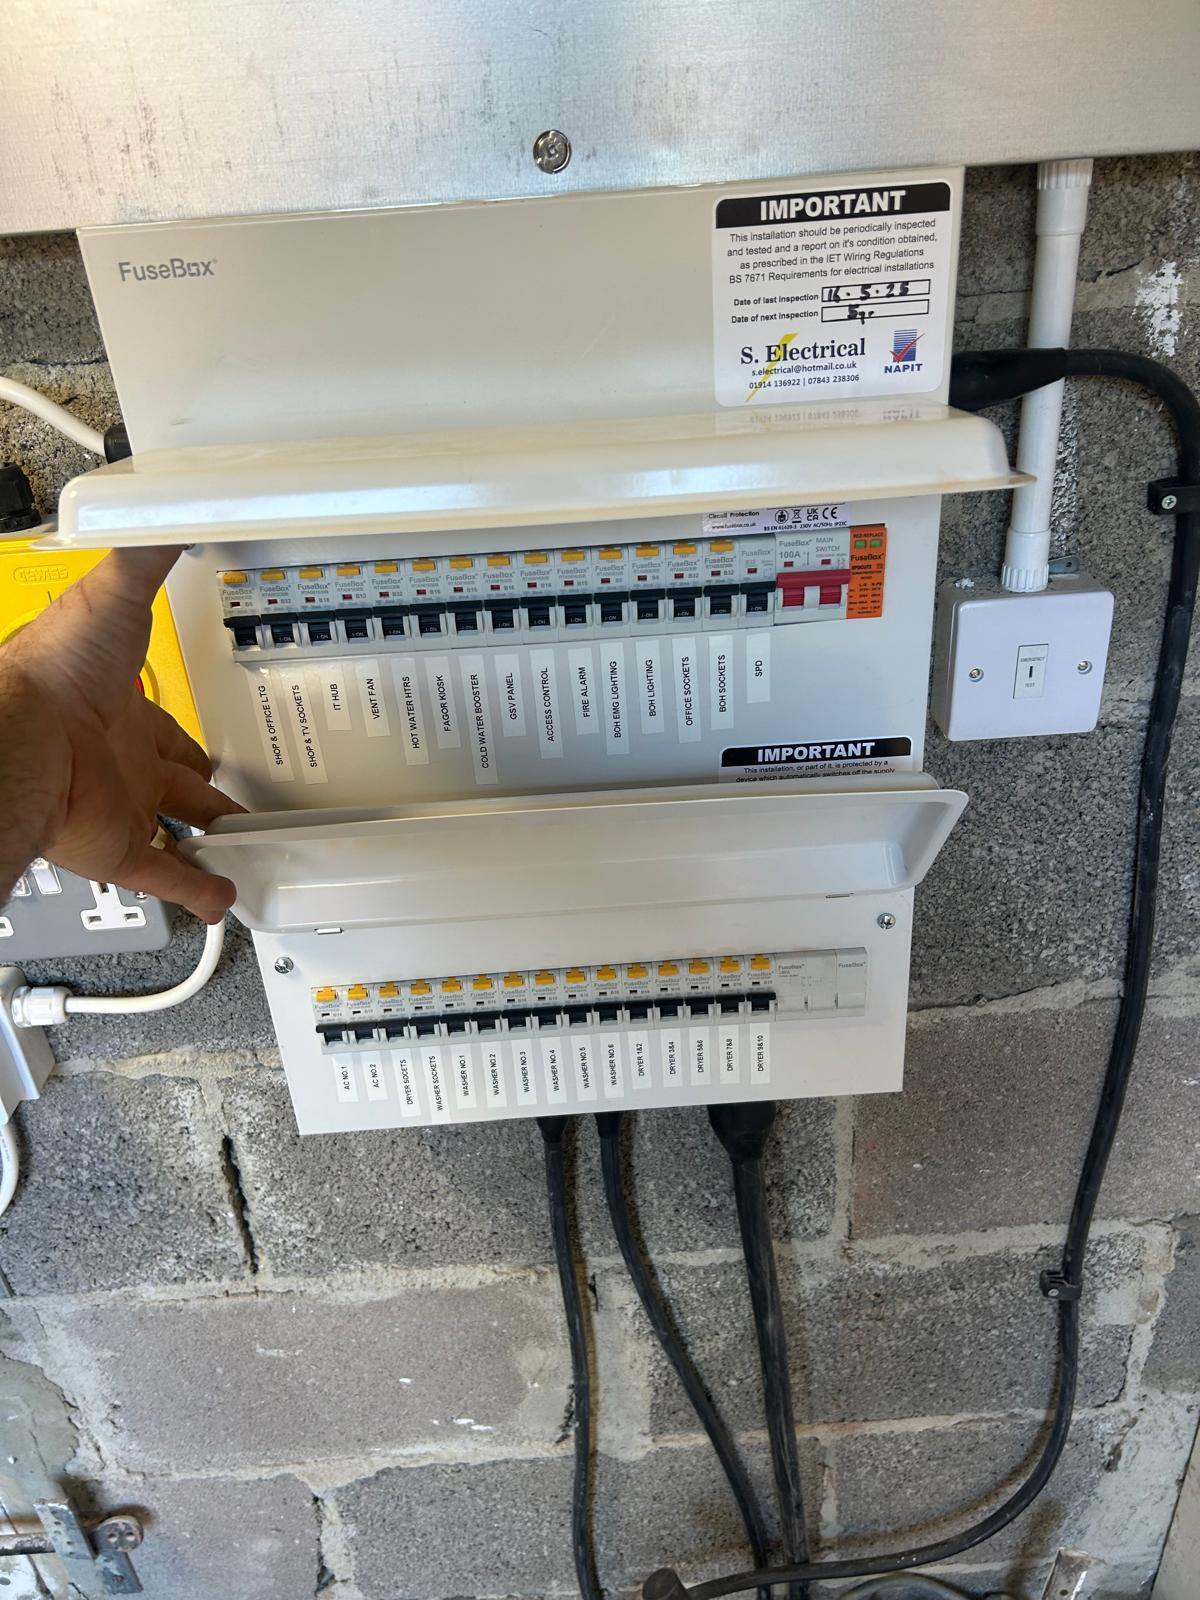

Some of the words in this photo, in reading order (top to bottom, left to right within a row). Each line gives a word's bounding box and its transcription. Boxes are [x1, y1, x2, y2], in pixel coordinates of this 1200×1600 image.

[761, 190, 906, 221] IMPORTANT
[730, 234, 747, 242] This
[751, 230, 796, 240] installation
[799, 227, 827, 237] should
[830, 226, 840, 234] be
[843, 222, 891, 235] periodically
[895, 218, 936, 230] inspected
[746, 246, 771, 255] tested
[775, 244, 790, 252] and
[802, 242, 826, 251] report
[843, 239, 854, 248] it's
[857, 236, 895, 247] condition
[753, 258, 797, 270] prescribed
[810, 255, 823, 264] the
[827, 254, 841, 262] IET
[844, 252, 870, 262] Wiring
[874, 249, 924, 260] Regulations
[730, 275, 742, 283] BS
[745, 273, 766, 282] 7671
[769, 269, 827, 281] Requirements
[830, 268, 841, 276] for
[844, 264, 881, 275] electrical
[885, 262, 934, 272] installations
[779, 293, 818, 303] inspection
[779, 311, 818, 320] inspection
[740, 347, 759, 365] S.
[766, 338, 866, 363] Electrical
[752, 361, 856, 376] s.electrical@hotmail.co.uk
[884, 363, 923, 374] NAPIT
[749, 381, 771, 389] 01914
[774, 379, 800, 388] 136922
[808, 376, 830, 385] 07843
[833, 374, 860, 383] 238306
[822, 507, 838, 519] CE
[14, 567, 68, 582] GEWISS
[366, 678, 376, 696] FAN
[505, 673, 516, 700] PANEL
[578, 666, 589, 696] ALARM
[610, 661, 619, 698] LIGHTING
[646, 659, 655, 697] LIGHTING
[682, 656, 691, 696] SOCKETS
[258, 685, 269, 702] LTG
[330, 683, 340, 701] HUB
[403, 676, 411, 699] HTRS
[436, 675, 447, 701] KIOSK
[470, 673, 482, 714] BOOSTER
[541, 668, 551, 707] CONTROL
[292, 684, 307, 724] SOCKETS
[369, 698, 379, 719] VENT
[508, 702, 517, 720] GSV
[582, 698, 590, 718] FIRE
[612, 700, 620, 720] EMG
[262, 703, 276, 734] OFFICE
[405, 700, 417, 732] WATER
[439, 702, 451, 732] FAGOR
[545, 708, 554, 742] ACCESS
[303, 724, 310, 736] TV
[411, 732, 419, 748] HOT
[476, 715, 486, 745] WATER
[272, 744, 283, 766] SHOP
[306, 746, 317, 768] SHOP
[480, 746, 488, 768] COLD
[758, 742, 875, 763] IMPORTANT
[400, 1059, 409, 1084] SOCETS
[429, 1056, 439, 1084] SOCKETS
[522, 1067, 530, 1093] WASHER
[551, 1065, 559, 1091] WASHER
[581, 1062, 590, 1089] WASHER
[344, 1081, 350, 1090] AC
[372, 1079, 379, 1088] AC
[461, 1070, 469, 1096] WASHER
[491, 1069, 499, 1096] WASHER
[404, 1086, 413, 1105] DRYER
[434, 1085, 443, 1111] WASHER
